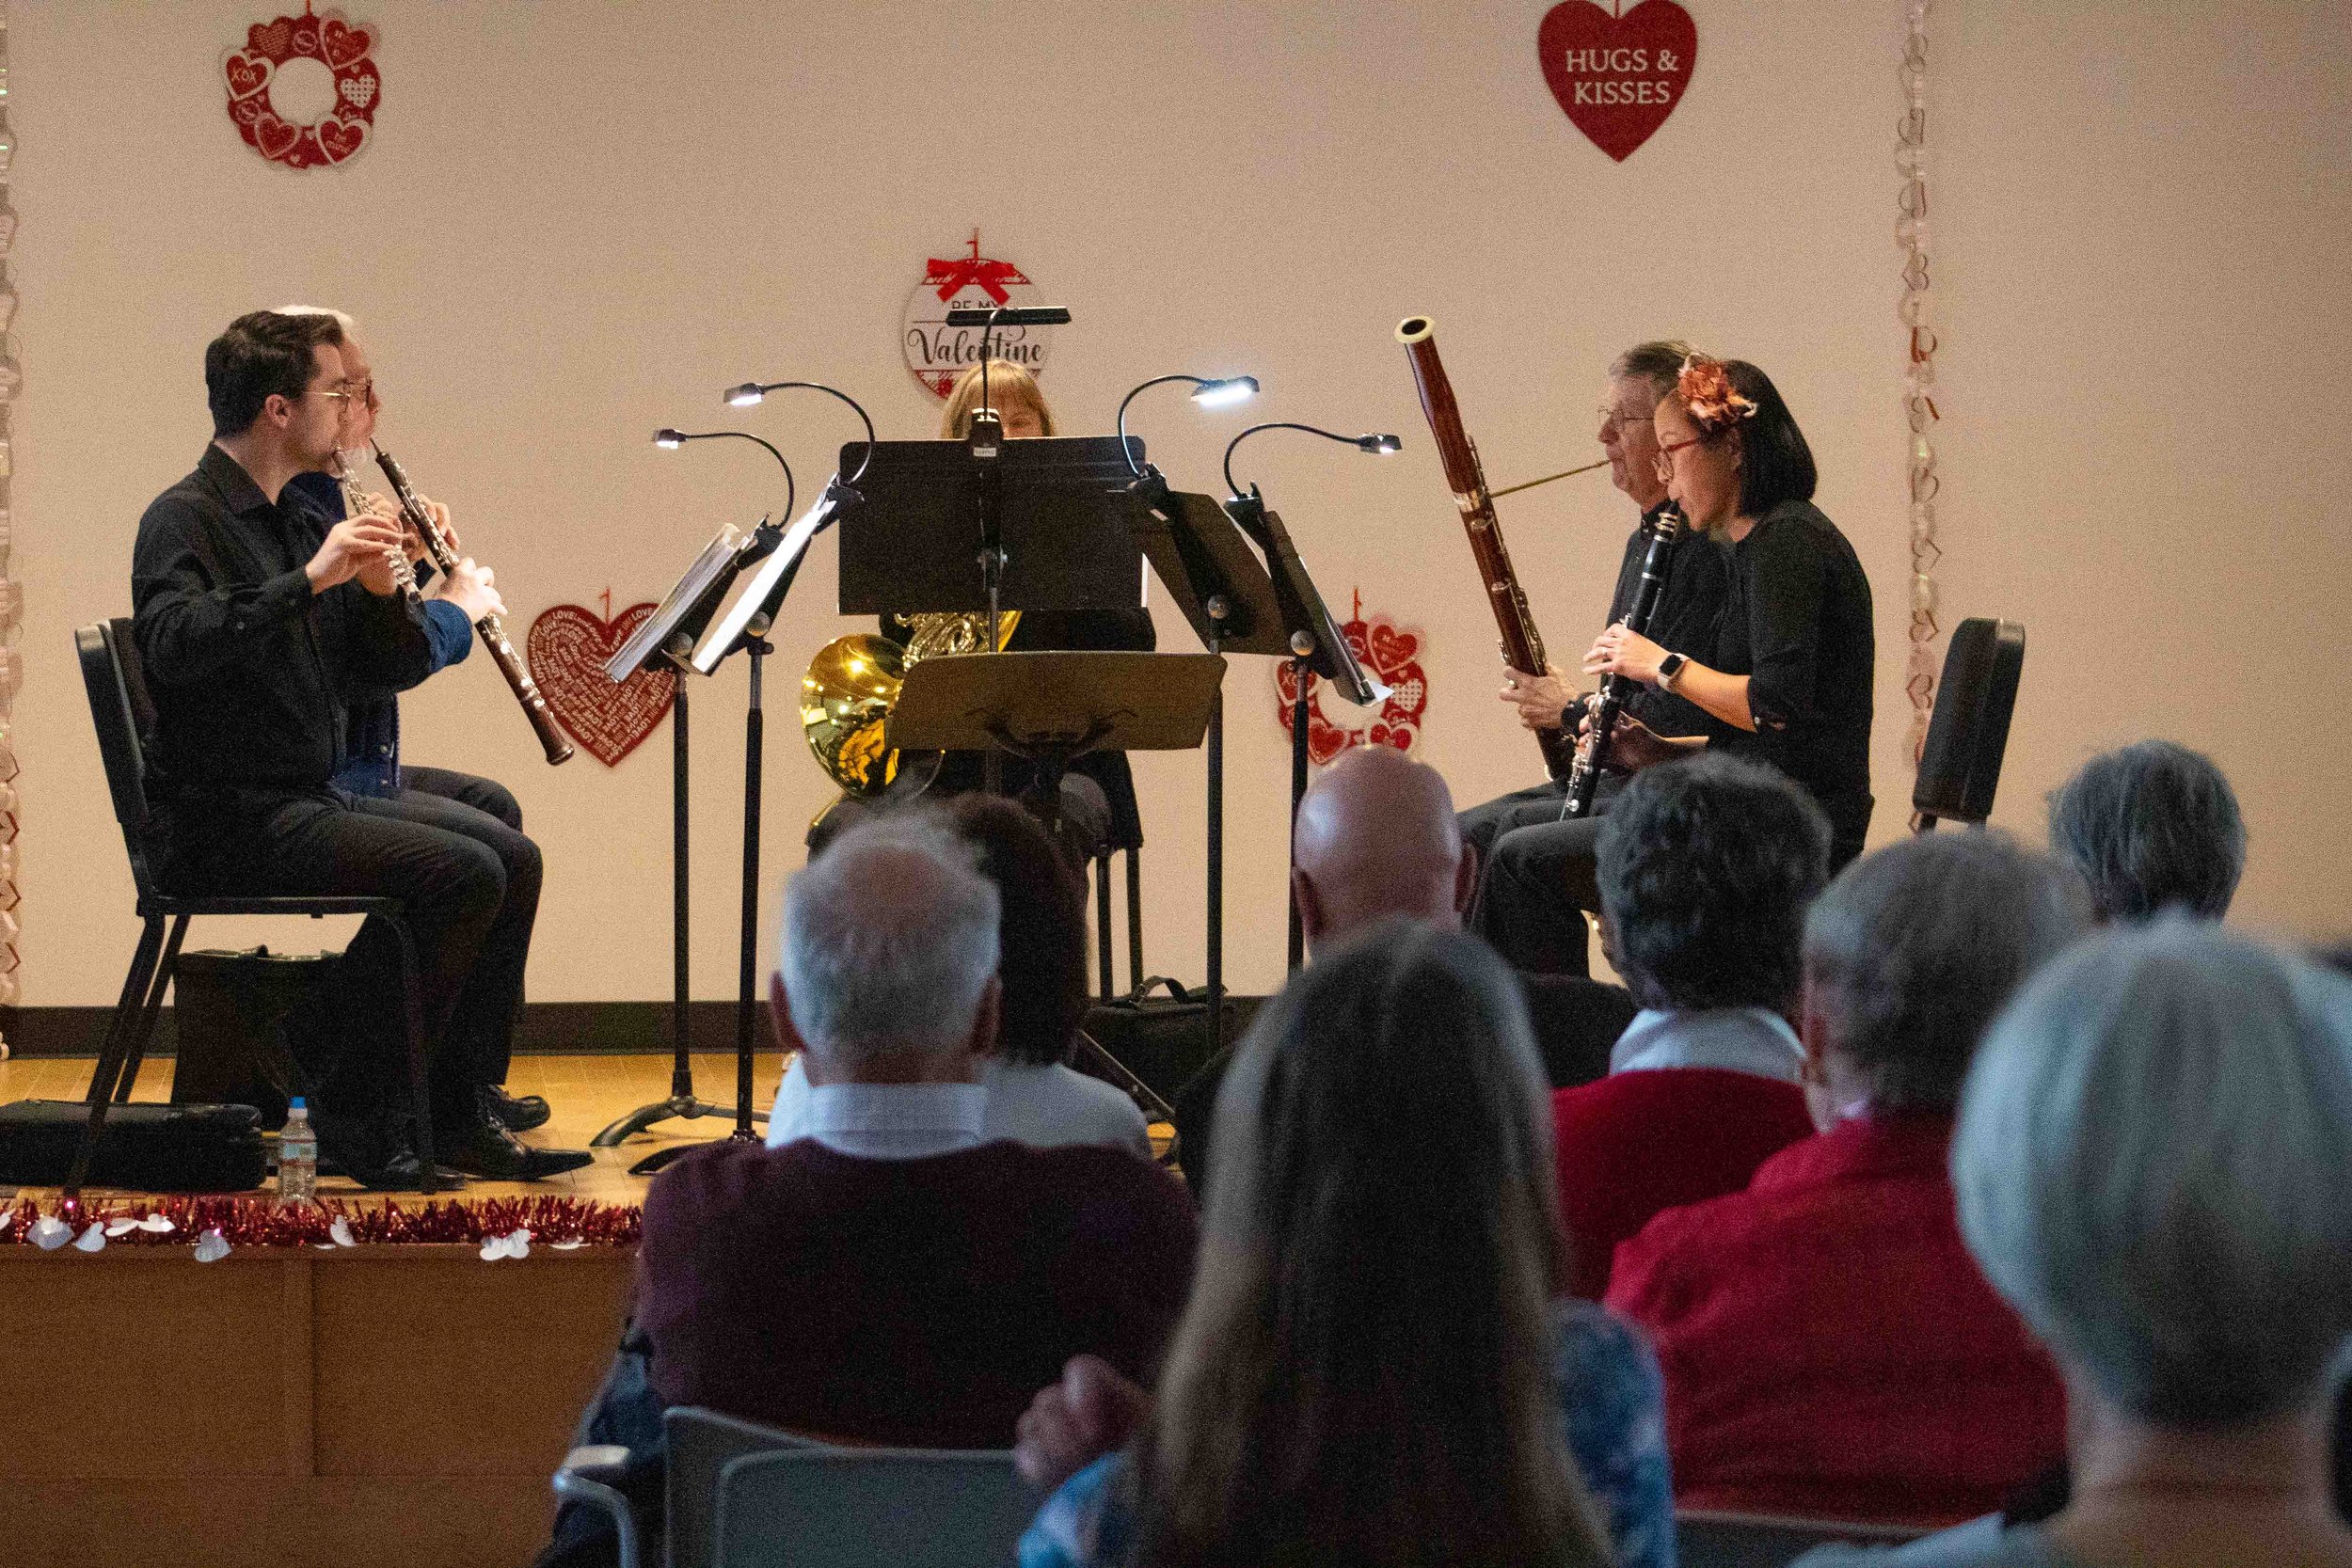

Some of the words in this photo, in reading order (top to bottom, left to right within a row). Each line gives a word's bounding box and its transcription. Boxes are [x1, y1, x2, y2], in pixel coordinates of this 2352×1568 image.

[1565, 48, 1648, 72] HUGS
[1657, 49, 1678, 71] &
[1574, 81, 1671, 104] KISSES
[908, 324, 1041, 365] Valentine
